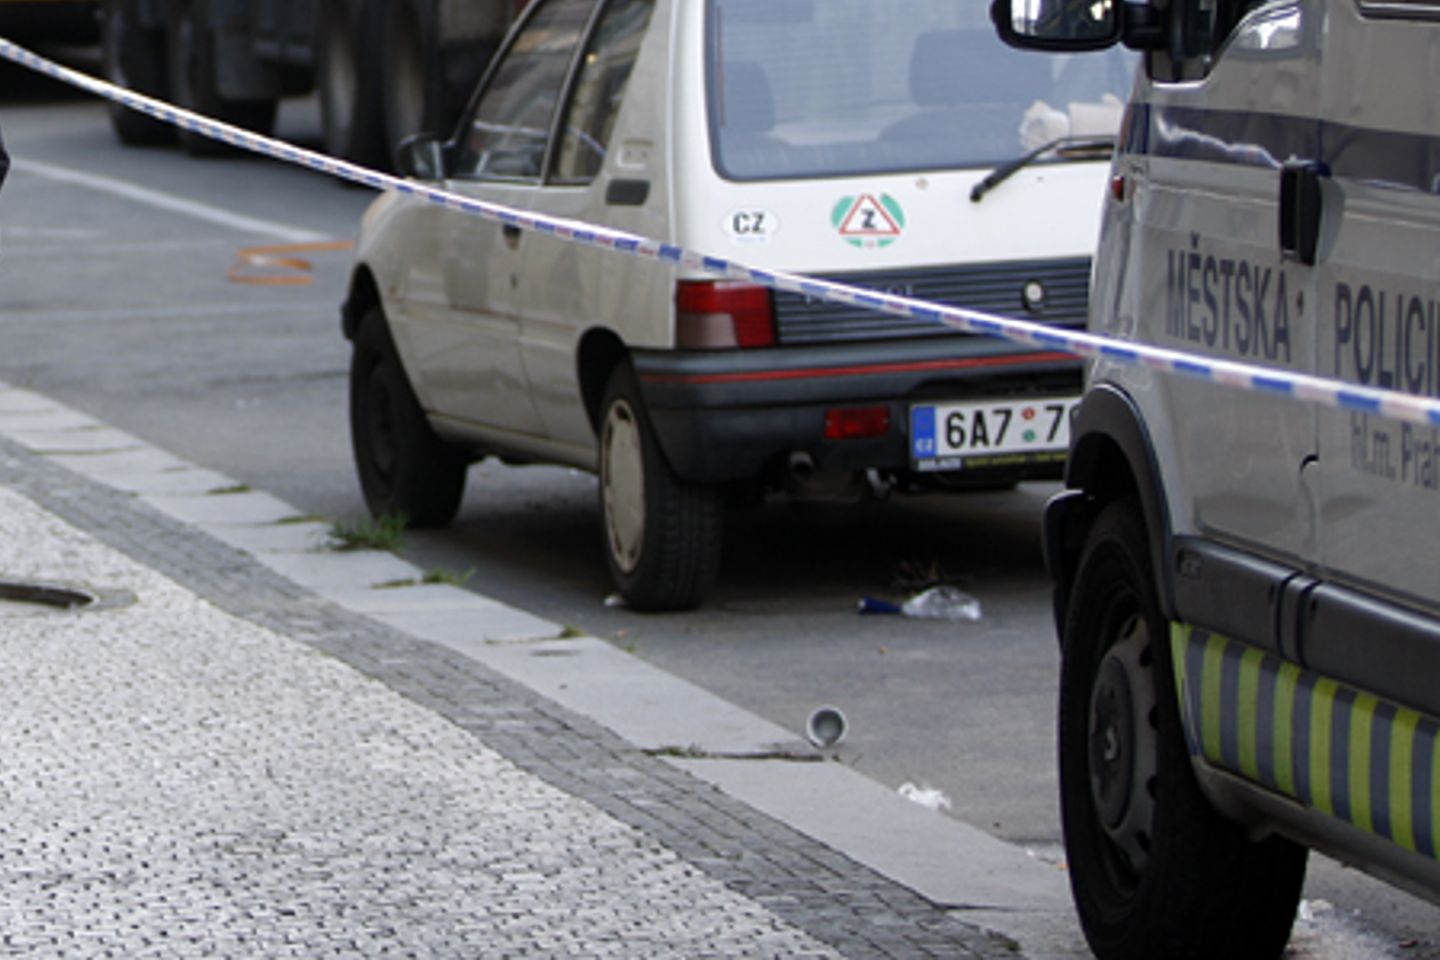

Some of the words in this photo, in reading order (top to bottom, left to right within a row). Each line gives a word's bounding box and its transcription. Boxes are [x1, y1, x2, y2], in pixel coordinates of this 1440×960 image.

[733, 211, 766, 235] CZ
[1335, 281, 1440, 399] POLICI
[946, 409, 1014, 449] 6A7
[1044, 404, 1076, 443] 7
